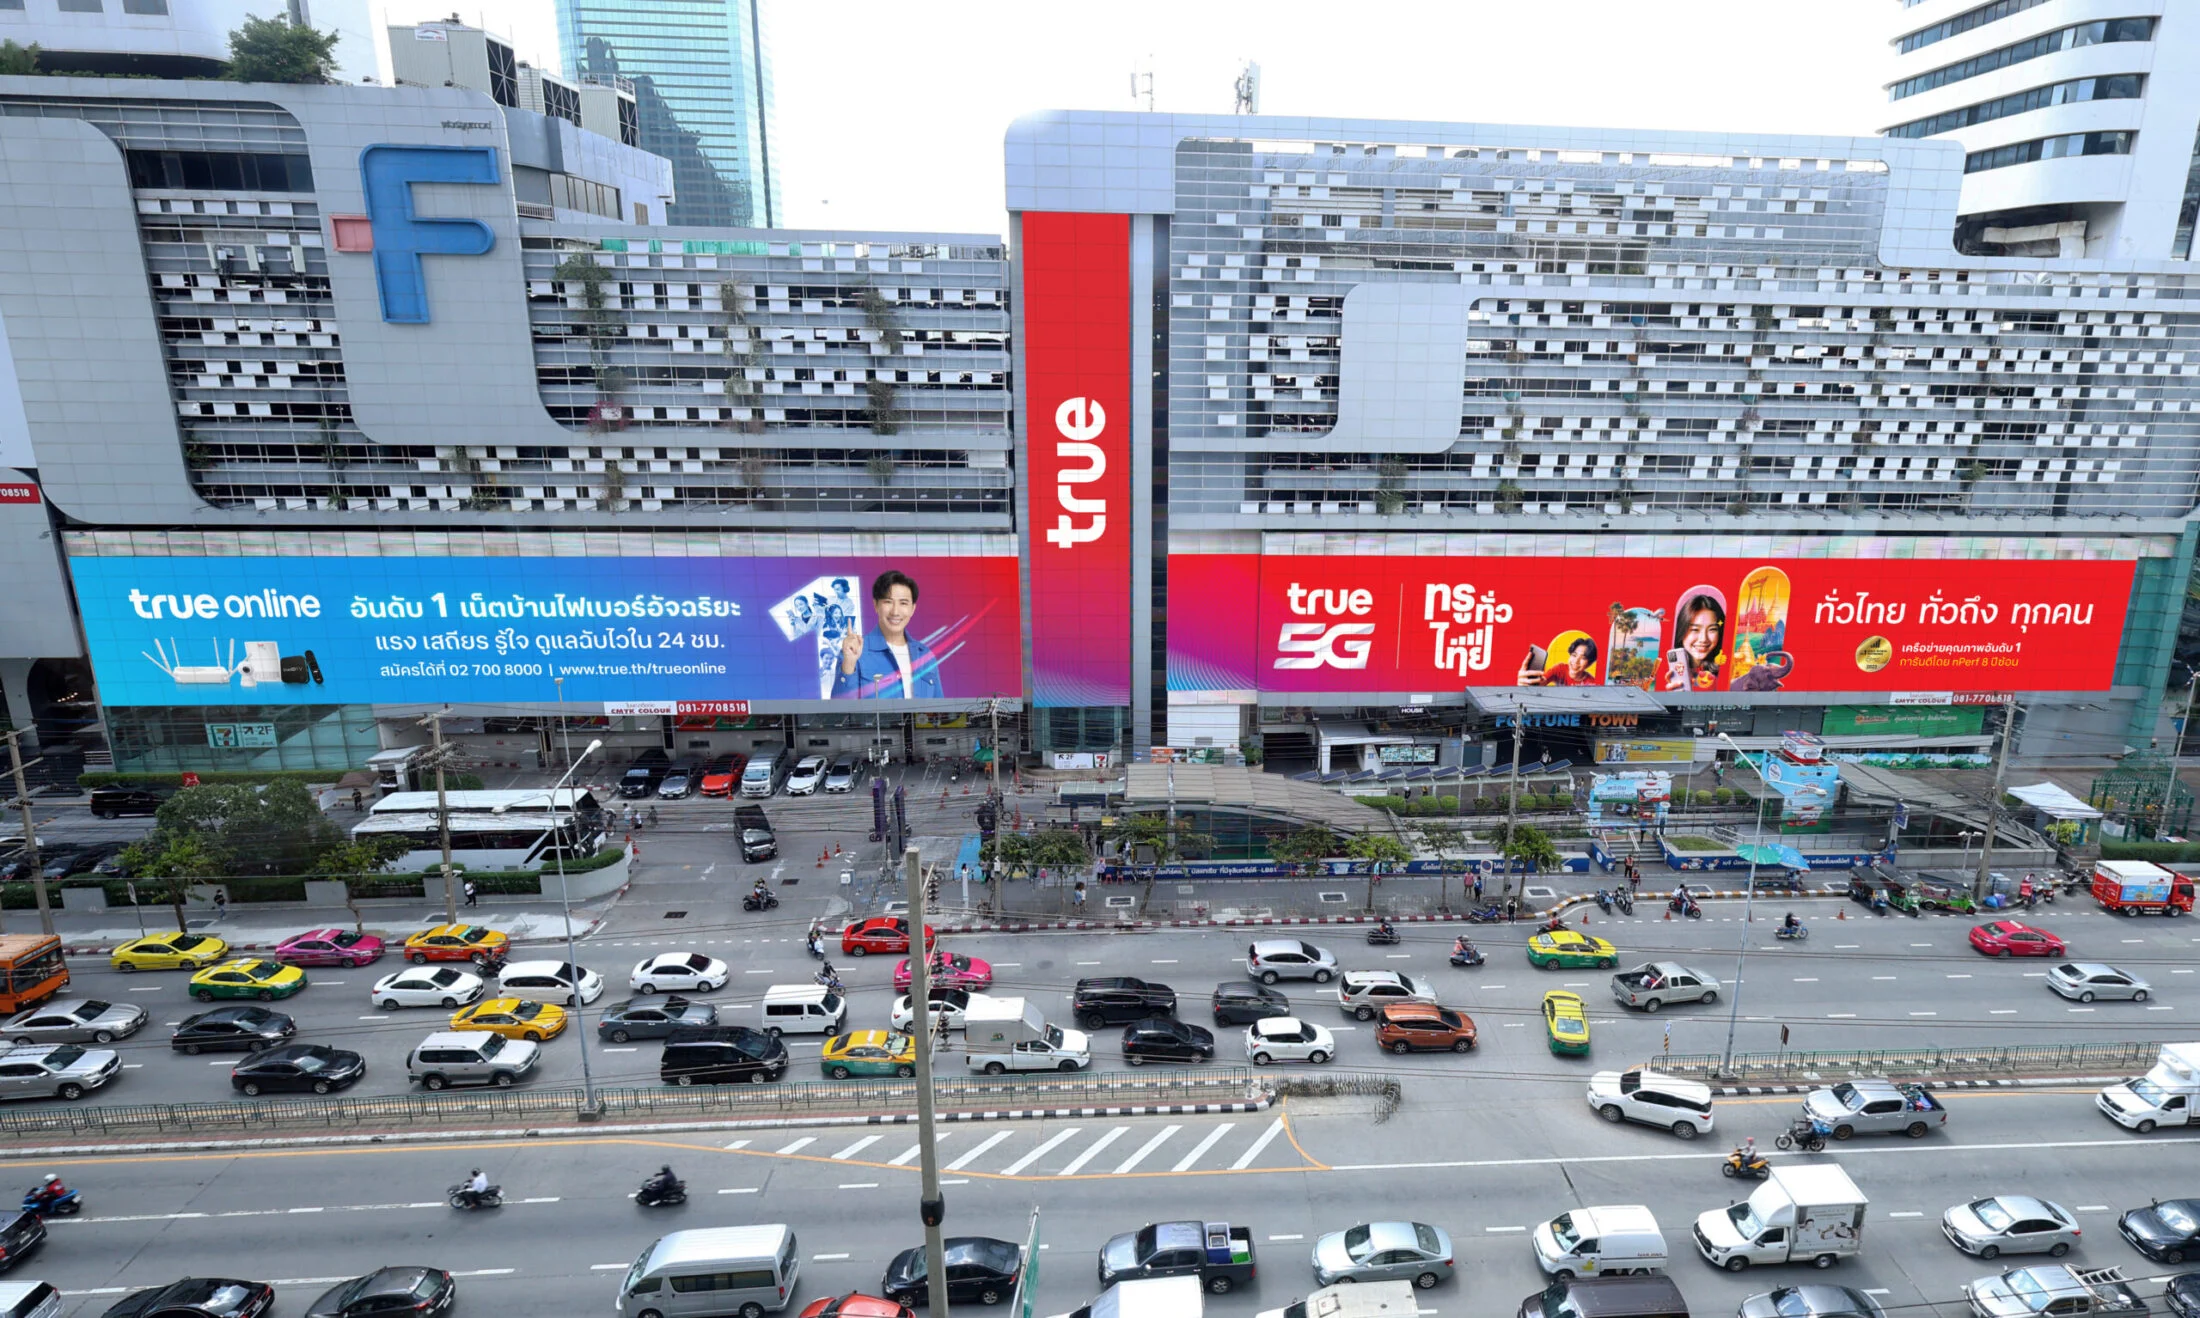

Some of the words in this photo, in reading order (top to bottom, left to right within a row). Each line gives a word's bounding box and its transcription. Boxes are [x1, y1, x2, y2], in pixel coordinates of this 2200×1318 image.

[1046, 397, 1106, 548] true
[0, 488, 30, 497] 08518
[128, 588, 219, 619] true
[223, 588, 321, 619] online
[350, 595, 423, 618] อันดับ
[431, 592, 448, 618] 1
[460, 593, 741, 618] เน็ตบ้านไฟเบอร์อัจฉริยะ
[1287, 582, 1374, 615] true
[1814, 589, 1905, 625] ทั่วไทย
[1919, 589, 1999, 625] ทั่วถึง
[2011, 602, 2094, 633] ทุกคน
[375, 634, 417, 650] แรง
[423, 630, 489, 650] เสถียร
[495, 627, 529, 656] รู้ใจ
[535, 627, 652, 656] ดูแลฉับไวใน
[658, 631, 685, 649] 24
[690, 632, 725, 649] ชม.
[1273, 623, 1376, 670] 5G
[2015, 642, 2021, 653] 1
[380, 660, 446, 677] สมัครได้ที่
[449, 664, 469, 676] 02
[472, 664, 500, 676] 700
[504, 663, 543, 676] 8000
[559, 662, 726, 675] www.true.th/trueonline
[1952, 656, 1979, 667] nPerf
[1981, 657, 1988, 667] 8
[678, 702, 747, 713] 081-7708518
[1588, 713, 1639, 726] TOWN
